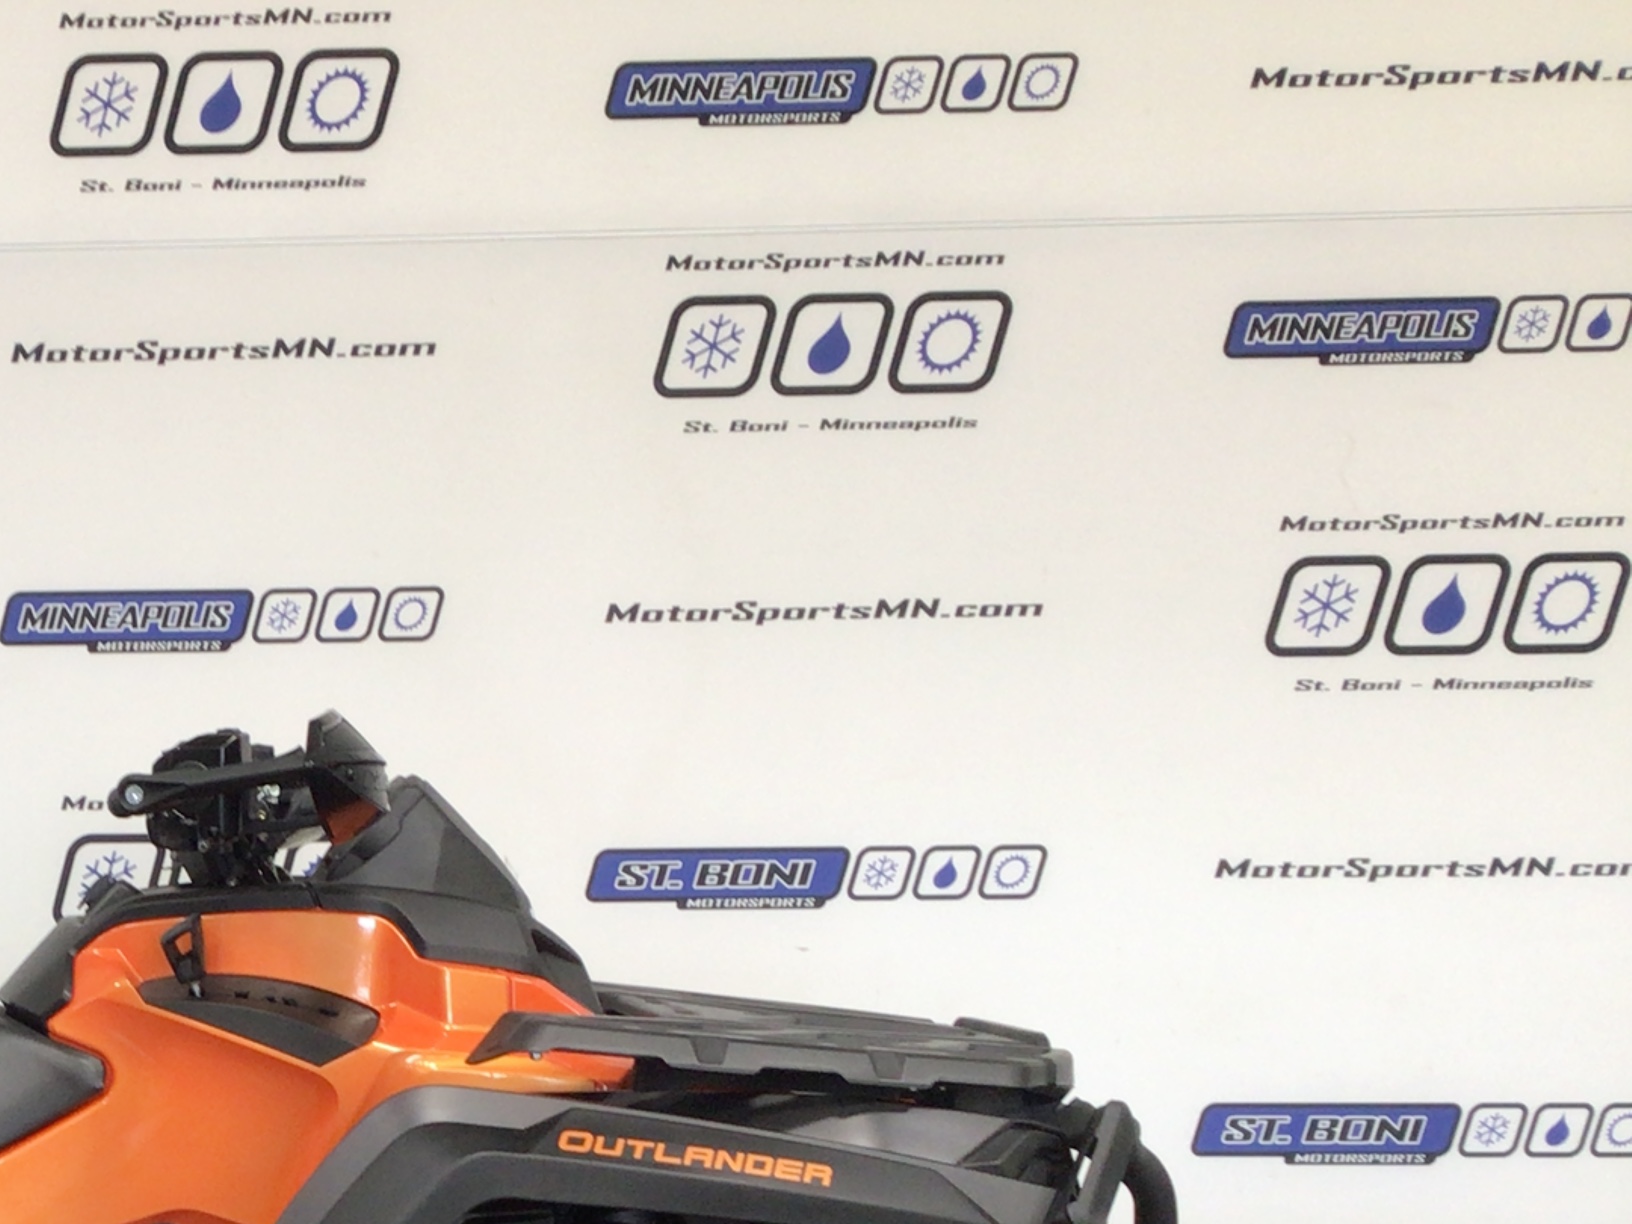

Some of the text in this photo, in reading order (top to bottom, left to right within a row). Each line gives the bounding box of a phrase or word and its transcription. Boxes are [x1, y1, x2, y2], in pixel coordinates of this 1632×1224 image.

[58, 7, 392, 32] MotorSportsMN.com
[625, 70, 855, 106] MINNEAPOLIS
[1249, 59, 1632, 92] MotorSportsMN.c
[708, 110, 843, 124] MOTORSPORTS
[79, 179, 113, 194] St.
[124, 178, 182, 192] Boni
[211, 174, 367, 192] Minneapolis
[665, 249, 1006, 274] MotorSportsMN.com
[1244, 309, 1479, 345] MINNEAPOLIS
[10, 336, 437, 366] MotorSportsMN.com
[1329, 350, 1466, 364] MOTORSPORTS
[682, 420, 718, 434] St.
[728, 419, 789, 433] Boni
[819, 415, 978, 432] Minneapolis
[1279, 511, 1626, 535] MotorSportsMN.com
[17, 601, 234, 634] MINNEAPOLIS
[604, 597, 1044, 627] MotorSportsMN.com
[97, 640, 223, 652] MOTORSPORTS
[1293, 678, 1330, 692] St.
[1340, 678, 1402, 692] Boni
[1432, 676, 1594, 692] Minneapolis
[614, 859, 816, 891] ST. BONI
[686, 896, 816, 909] MOTORSPORTS
[1220, 1115, 1428, 1145] ST. BONI
[557, 1128, 834, 1188] OUTLANDER
[1294, 1151, 1427, 1164] MOTORSPORTS
